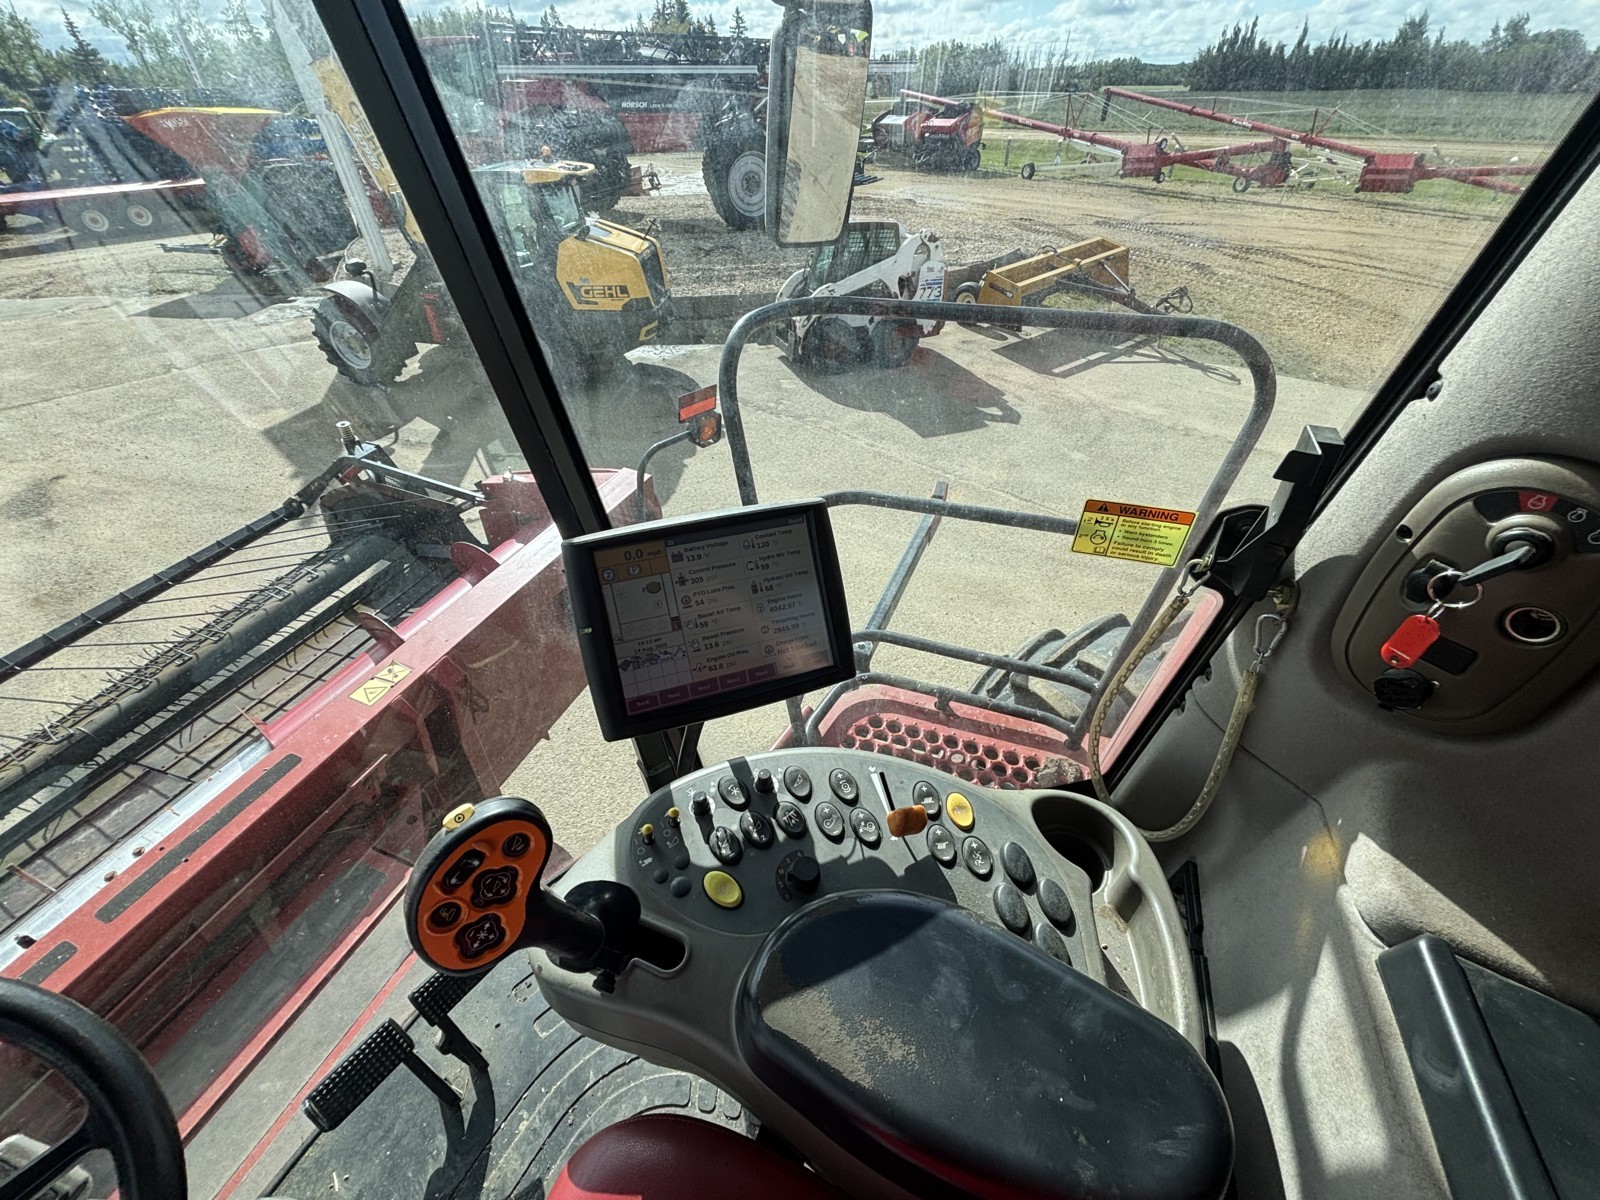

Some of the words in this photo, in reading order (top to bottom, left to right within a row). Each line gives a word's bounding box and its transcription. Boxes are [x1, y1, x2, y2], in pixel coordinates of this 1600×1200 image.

[348, 100, 384, 168] GEHL
[580, 286, 628, 298] GEHL
[919, 285, 942, 300] 773
[1119, 506, 1180, 522] WARNING
[1138, 531, 1168, 540] bystanders
[757, 541, 770, 549] 120
[624, 549, 643, 561] 0.0
[686, 554, 702, 562] 13.9
[758, 554, 776, 562] Hydro
[688, 566, 711, 575] Control
[711, 562, 736, 570] Pressure
[767, 596, 786, 604] Engine
[697, 611, 715, 619] Boost
[771, 615, 798, 625] Threshing
[702, 633, 720, 641] Boost
[720, 628, 744, 637] Pressure
[791, 640, 818, 652] blocked
[706, 654, 726, 663] Engine
[708, 663, 724, 672] 63.8
